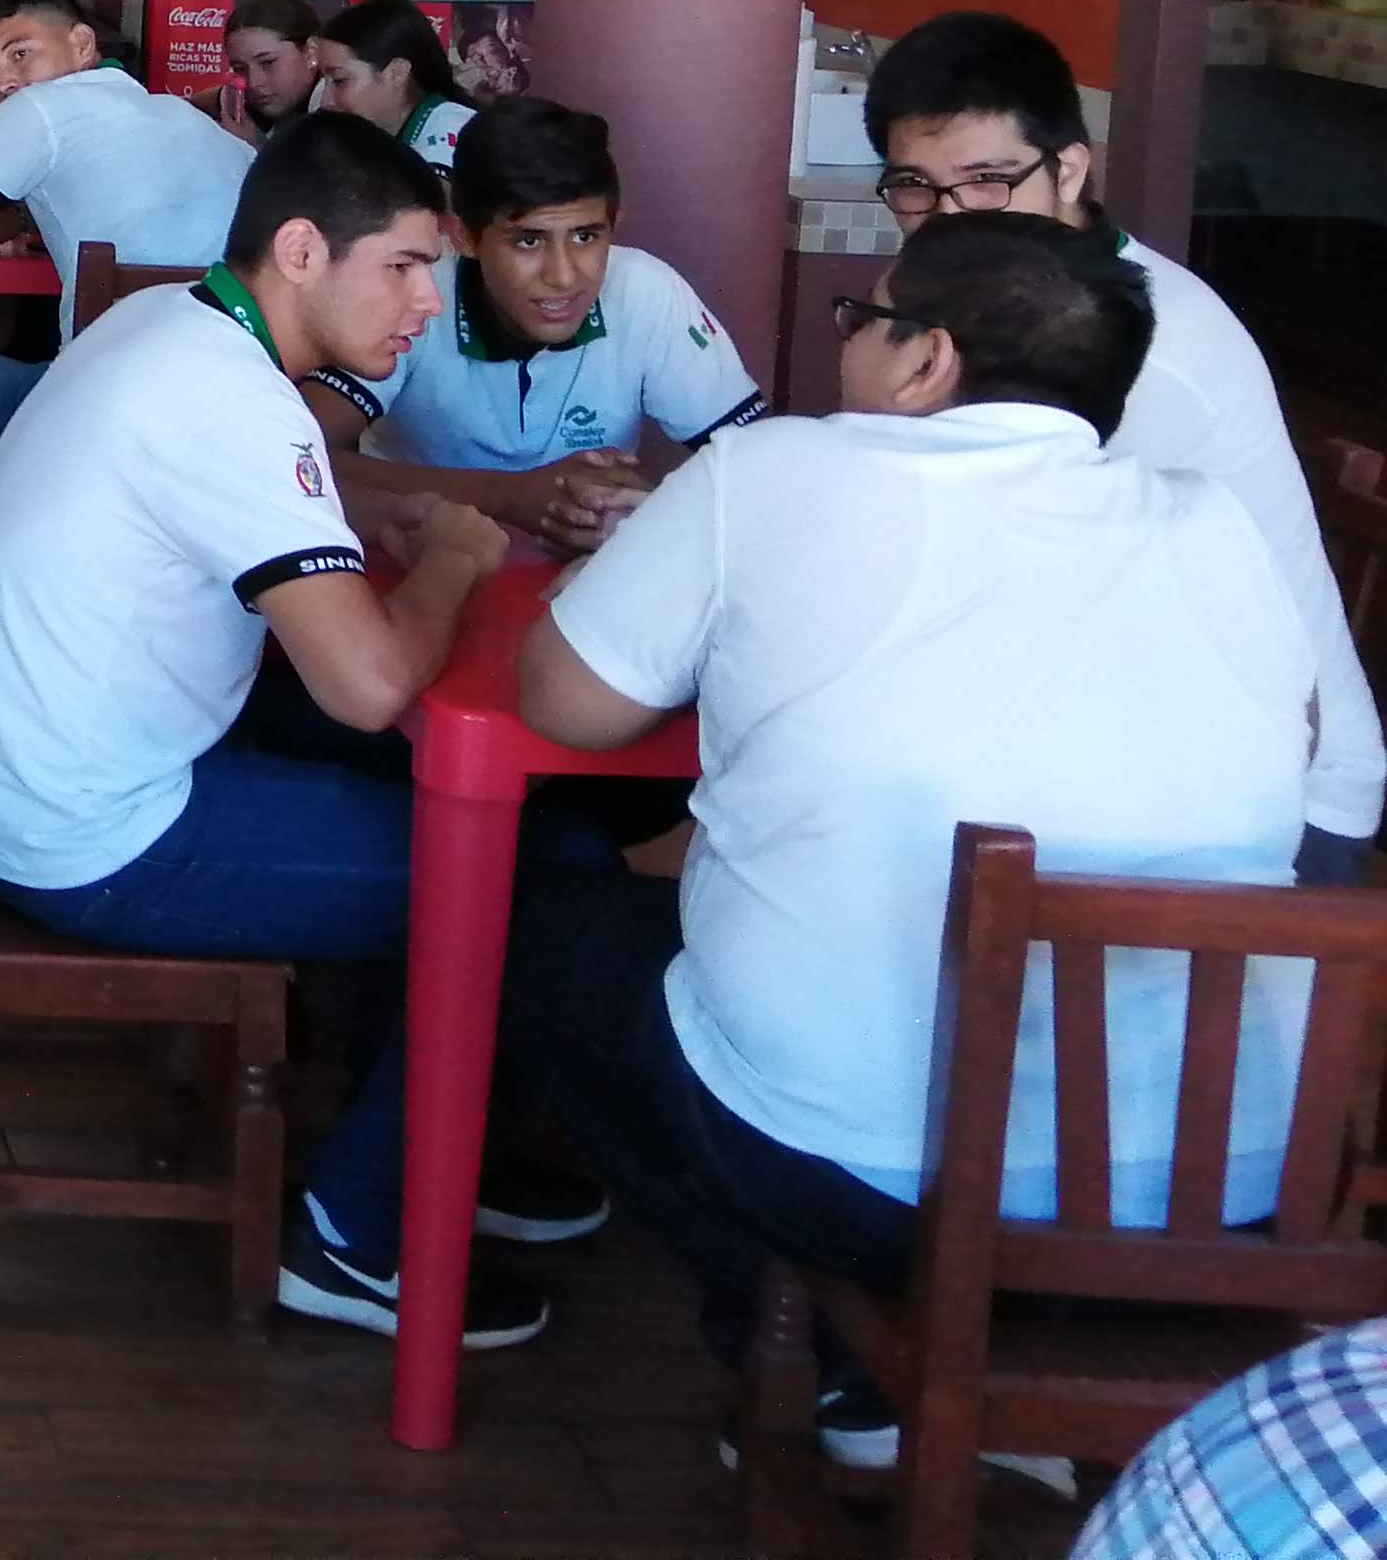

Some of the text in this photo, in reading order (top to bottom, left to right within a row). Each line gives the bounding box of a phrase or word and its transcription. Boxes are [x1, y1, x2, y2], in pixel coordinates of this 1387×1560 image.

[170, 42, 195, 52] HAZ
[202, 54, 222, 63] TUS
[169, 62, 221, 73] COMIDAS
